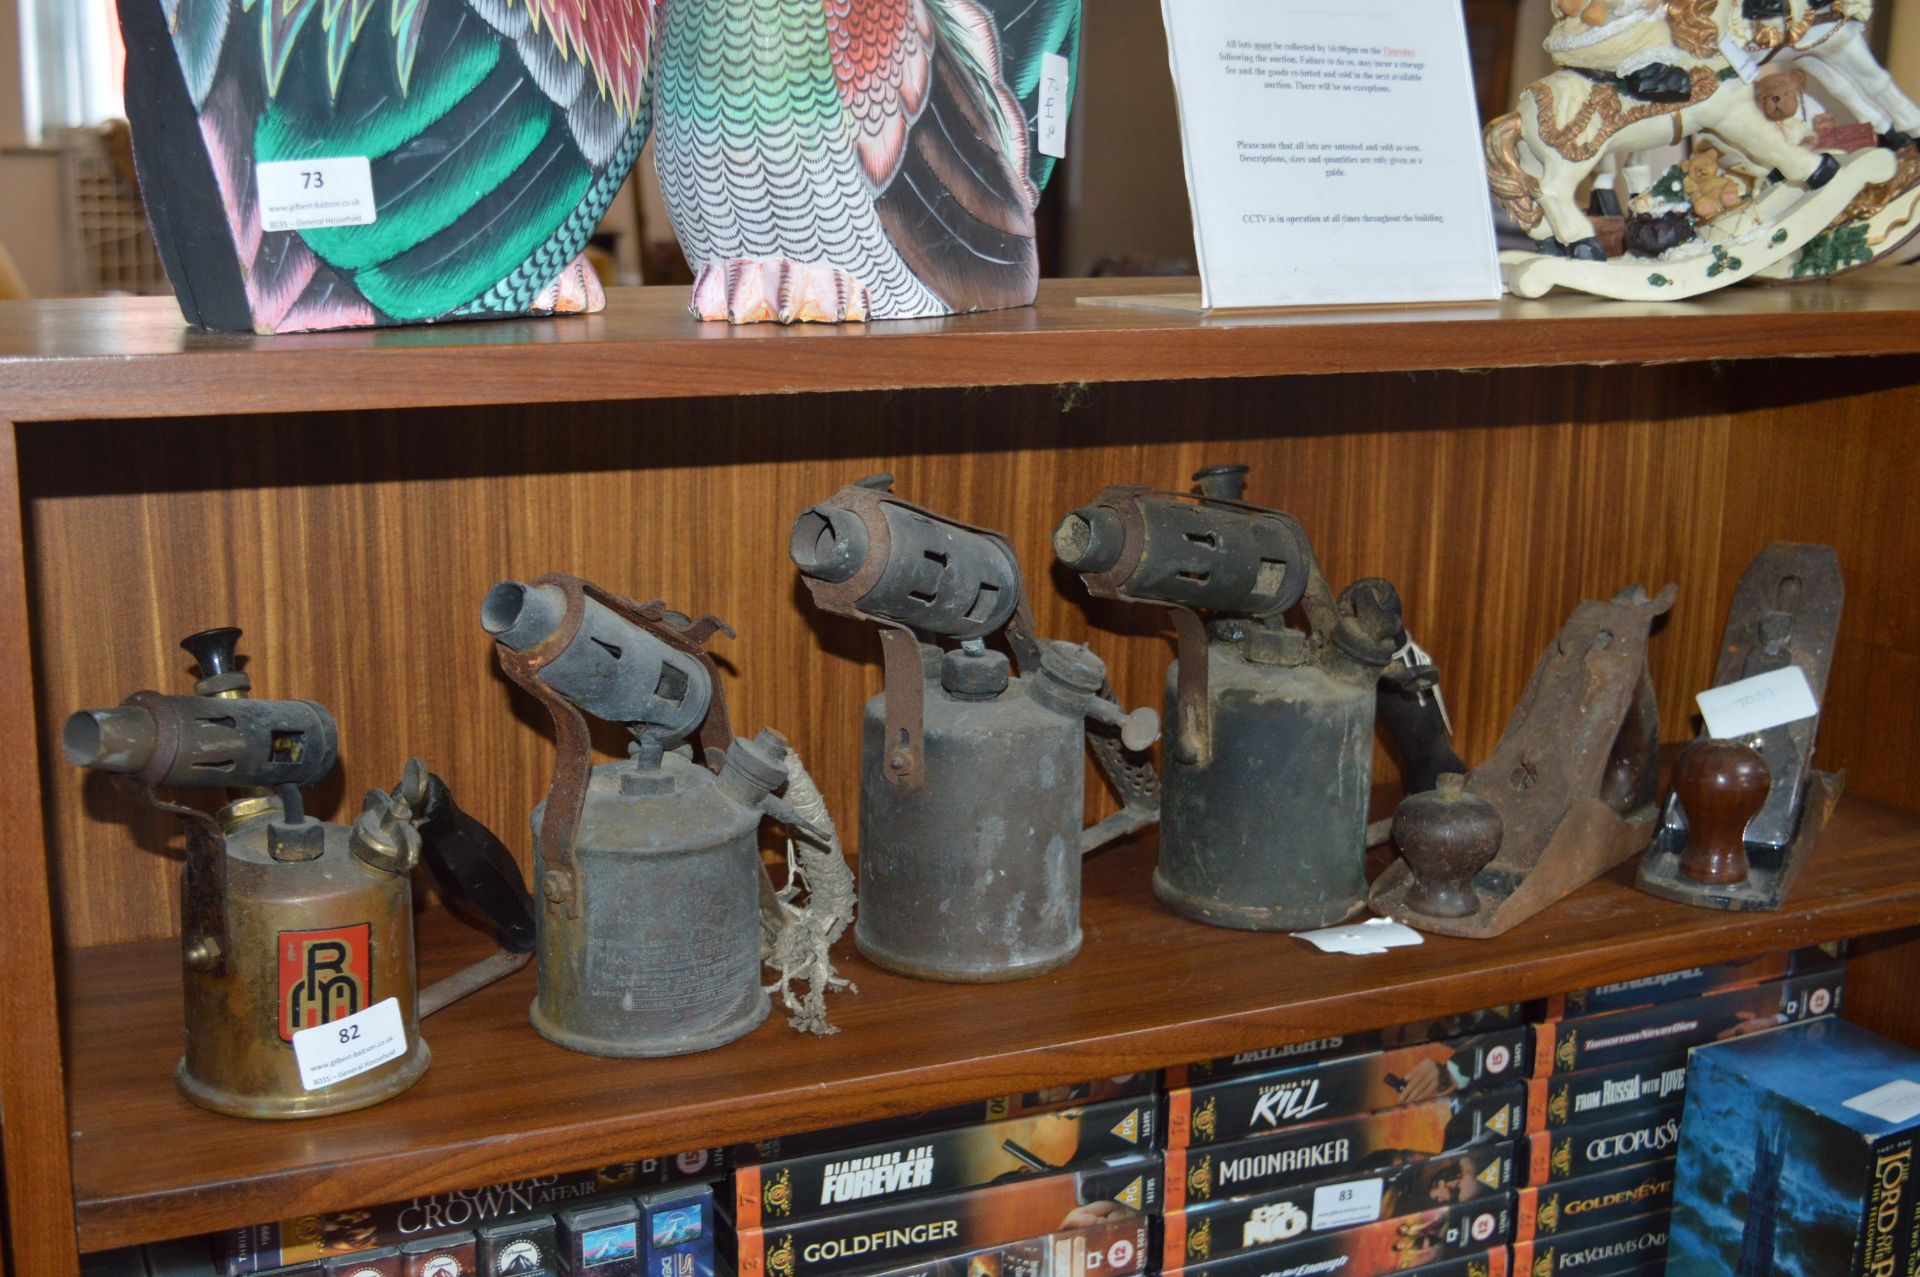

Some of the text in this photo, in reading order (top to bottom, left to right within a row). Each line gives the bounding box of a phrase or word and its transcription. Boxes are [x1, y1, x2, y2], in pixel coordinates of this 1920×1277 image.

[1238, 41, 1252, 49] lots
[1253, 43, 1272, 52] must
[1274, 42, 1282, 50] be
[1285, 43, 1315, 52] collected
[1370, 46, 1381, 54] the
[1219, 52, 1255, 64] following
[1255, 55, 1267, 63] the
[1300, 56, 1325, 65] Failure
[1225, 66, 1236, 75] fee
[1238, 67, 1252, 75] and
[1254, 67, 1266, 76] the
[1268, 68, 1288, 77] goods
[1323, 71, 1336, 79] and
[1295, 81, 1316, 90] There
[1237, 141, 1259, 150] Please
[1260, 142, 1276, 150] note
[1278, 142, 1293, 150] that
[1295, 142, 1304, 150] all
[1334, 143, 1363, 151] untested
[1365, 143, 1377, 151] and
[1239, 154, 1287, 165] Descriptions,
[1308, 155, 1321, 163] and
[1323, 156, 1357, 166] quantities
[301, 171, 324, 189] 73
[1242, 215, 1266, 223] CCTV
[1286, 215, 1320, 225] operation
[1332, 215, 1340, 223] all
[1342, 215, 1360, 223] times
[1362, 215, 1400, 224] throughout
[1402, 215, 1413, 223] the
[339, 1024, 361, 1044] 82
[338, 1063, 364, 1078] General
[365, 1049, 396, 1067] Household
[1575, 1068, 1685, 1112] FROM RUSSIA WITH LOVE
[1250, 1079, 1328, 1127] KILL
[1122, 1118, 1135, 1136] PG
[1586, 1118, 1681, 1162] OCTOPUSSY
[824, 1145, 934, 1178] DIAMONDS ARE
[1219, 1138, 1349, 1187] MOONRAKER
[820, 1157, 934, 1205] FOREVER
[1875, 1147, 1912, 1233] LORD
[1126, 1186, 1138, 1202] PG
[1339, 1189, 1353, 1201] 83
[397, 1186, 534, 1234] CROWN
[538, 1181, 597, 1204] AFFAIR
[1243, 1208, 1308, 1248] NO
[804, 1220, 958, 1262] GOLDFINGER
[1114, 1247, 1126, 1261] 12
[1559, 1233, 1668, 1270] FOR YOUR EYES ONLY
